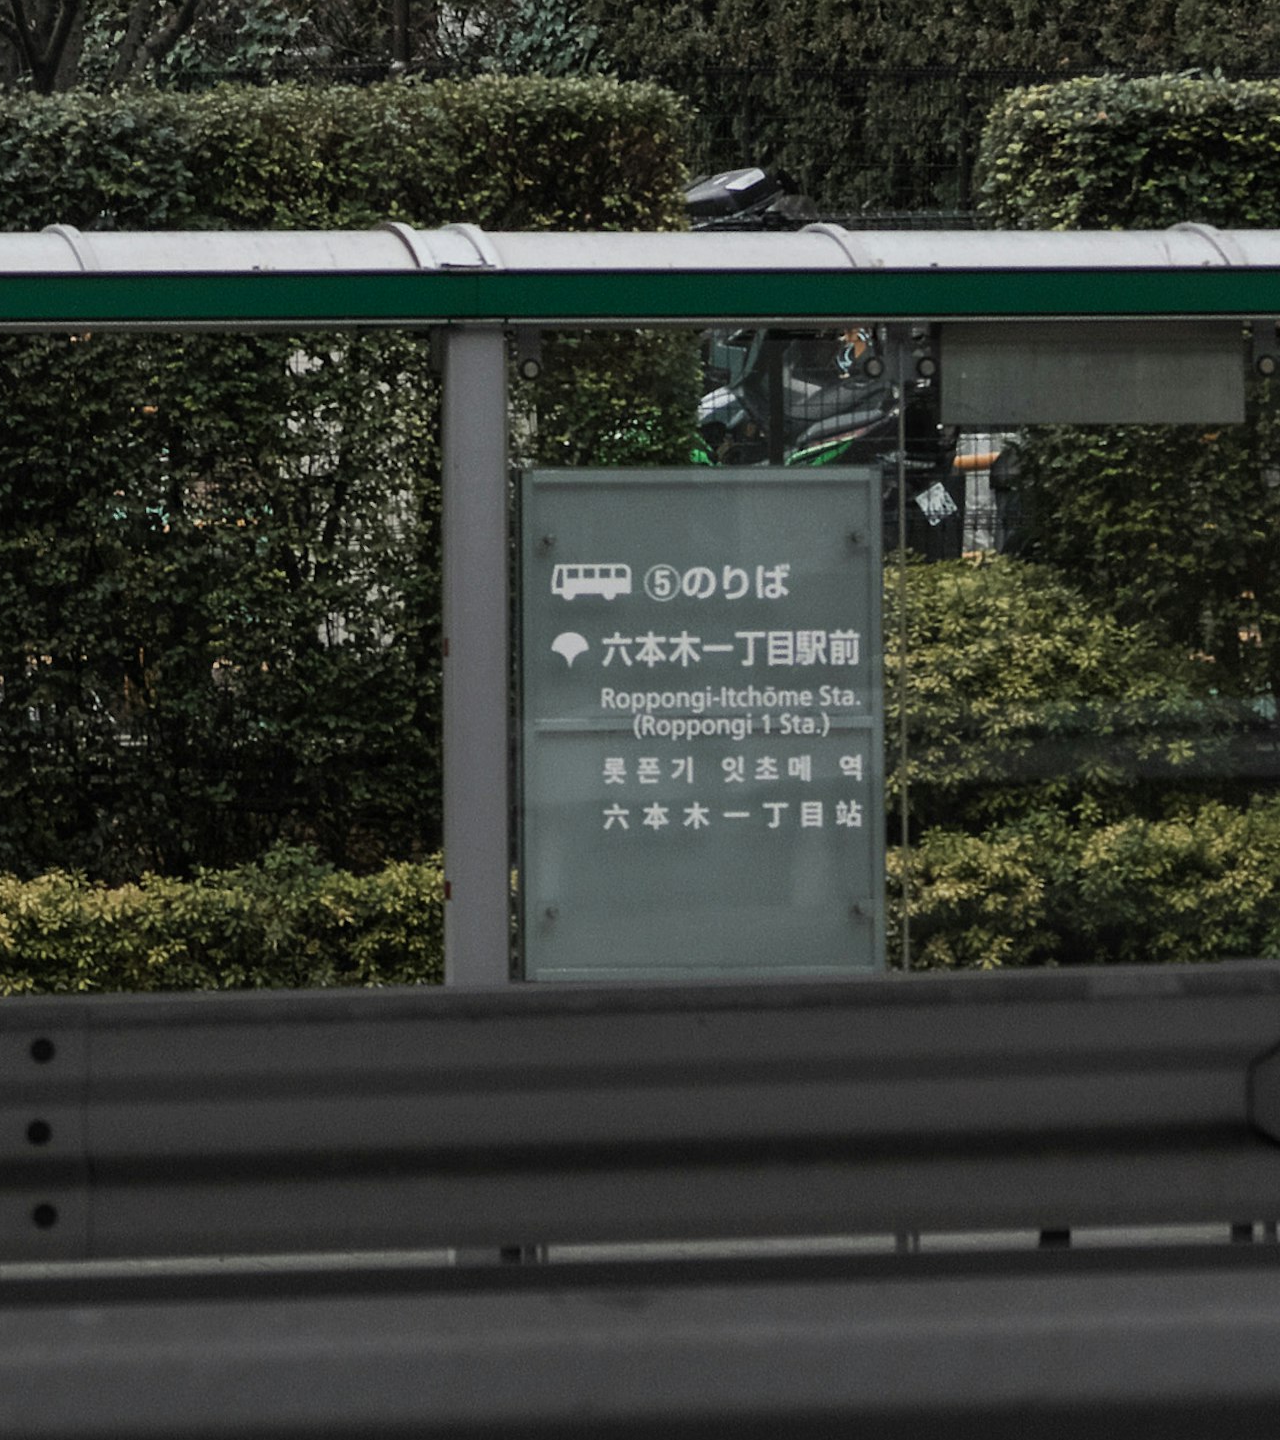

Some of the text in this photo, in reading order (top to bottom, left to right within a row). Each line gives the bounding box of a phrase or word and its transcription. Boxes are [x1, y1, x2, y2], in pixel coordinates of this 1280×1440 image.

[602, 629, 860, 668] 六本木一丁目駅前
[601, 685, 861, 713] Roppongi-Itchōme Sta.
[633, 713, 831, 740] (Roppongi 1 Sta.)
[602, 754, 863, 784] 롯폰기 잇초메 역
[603, 799, 862, 830] 六本木一丁目站
